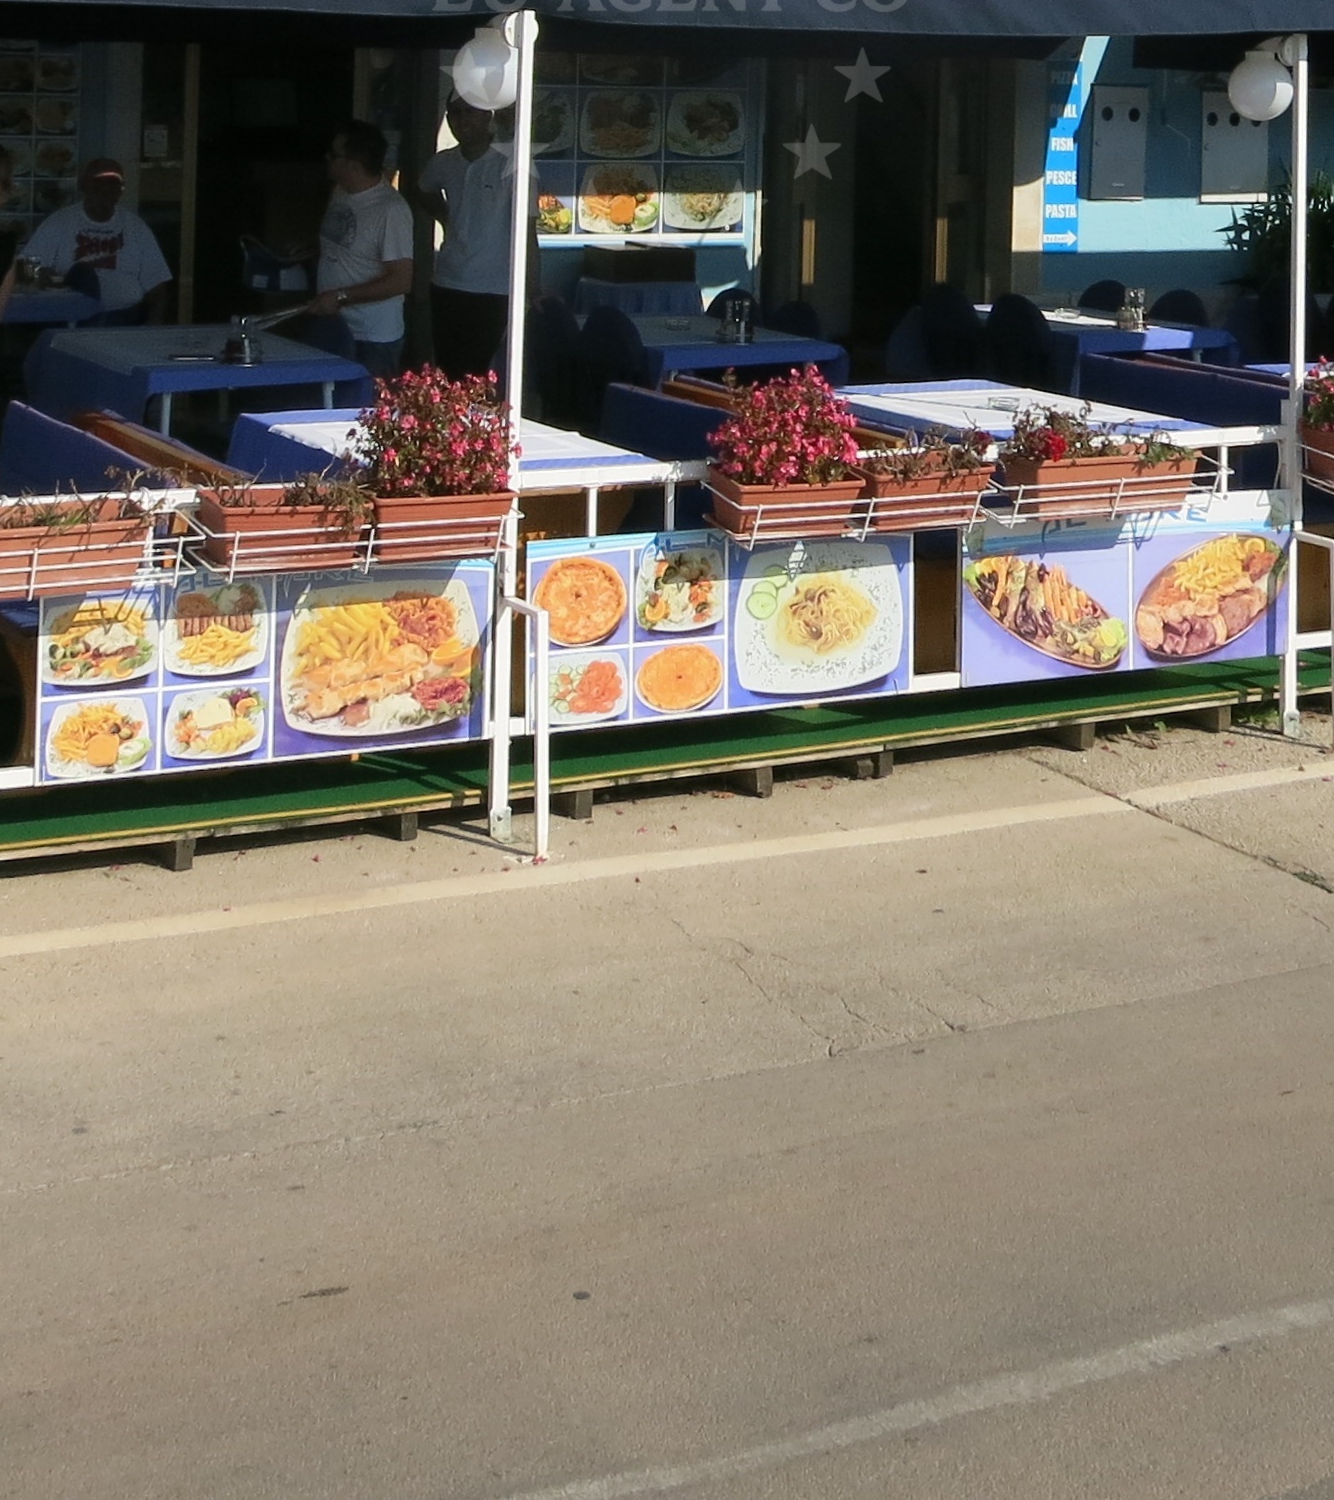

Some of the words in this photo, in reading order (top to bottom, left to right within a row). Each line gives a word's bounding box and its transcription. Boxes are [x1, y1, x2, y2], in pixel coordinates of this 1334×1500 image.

[1051, 137, 1075, 151] FISH
[1046, 170, 1078, 185] PESCE
[1045, 204, 1078, 218] PASTA
